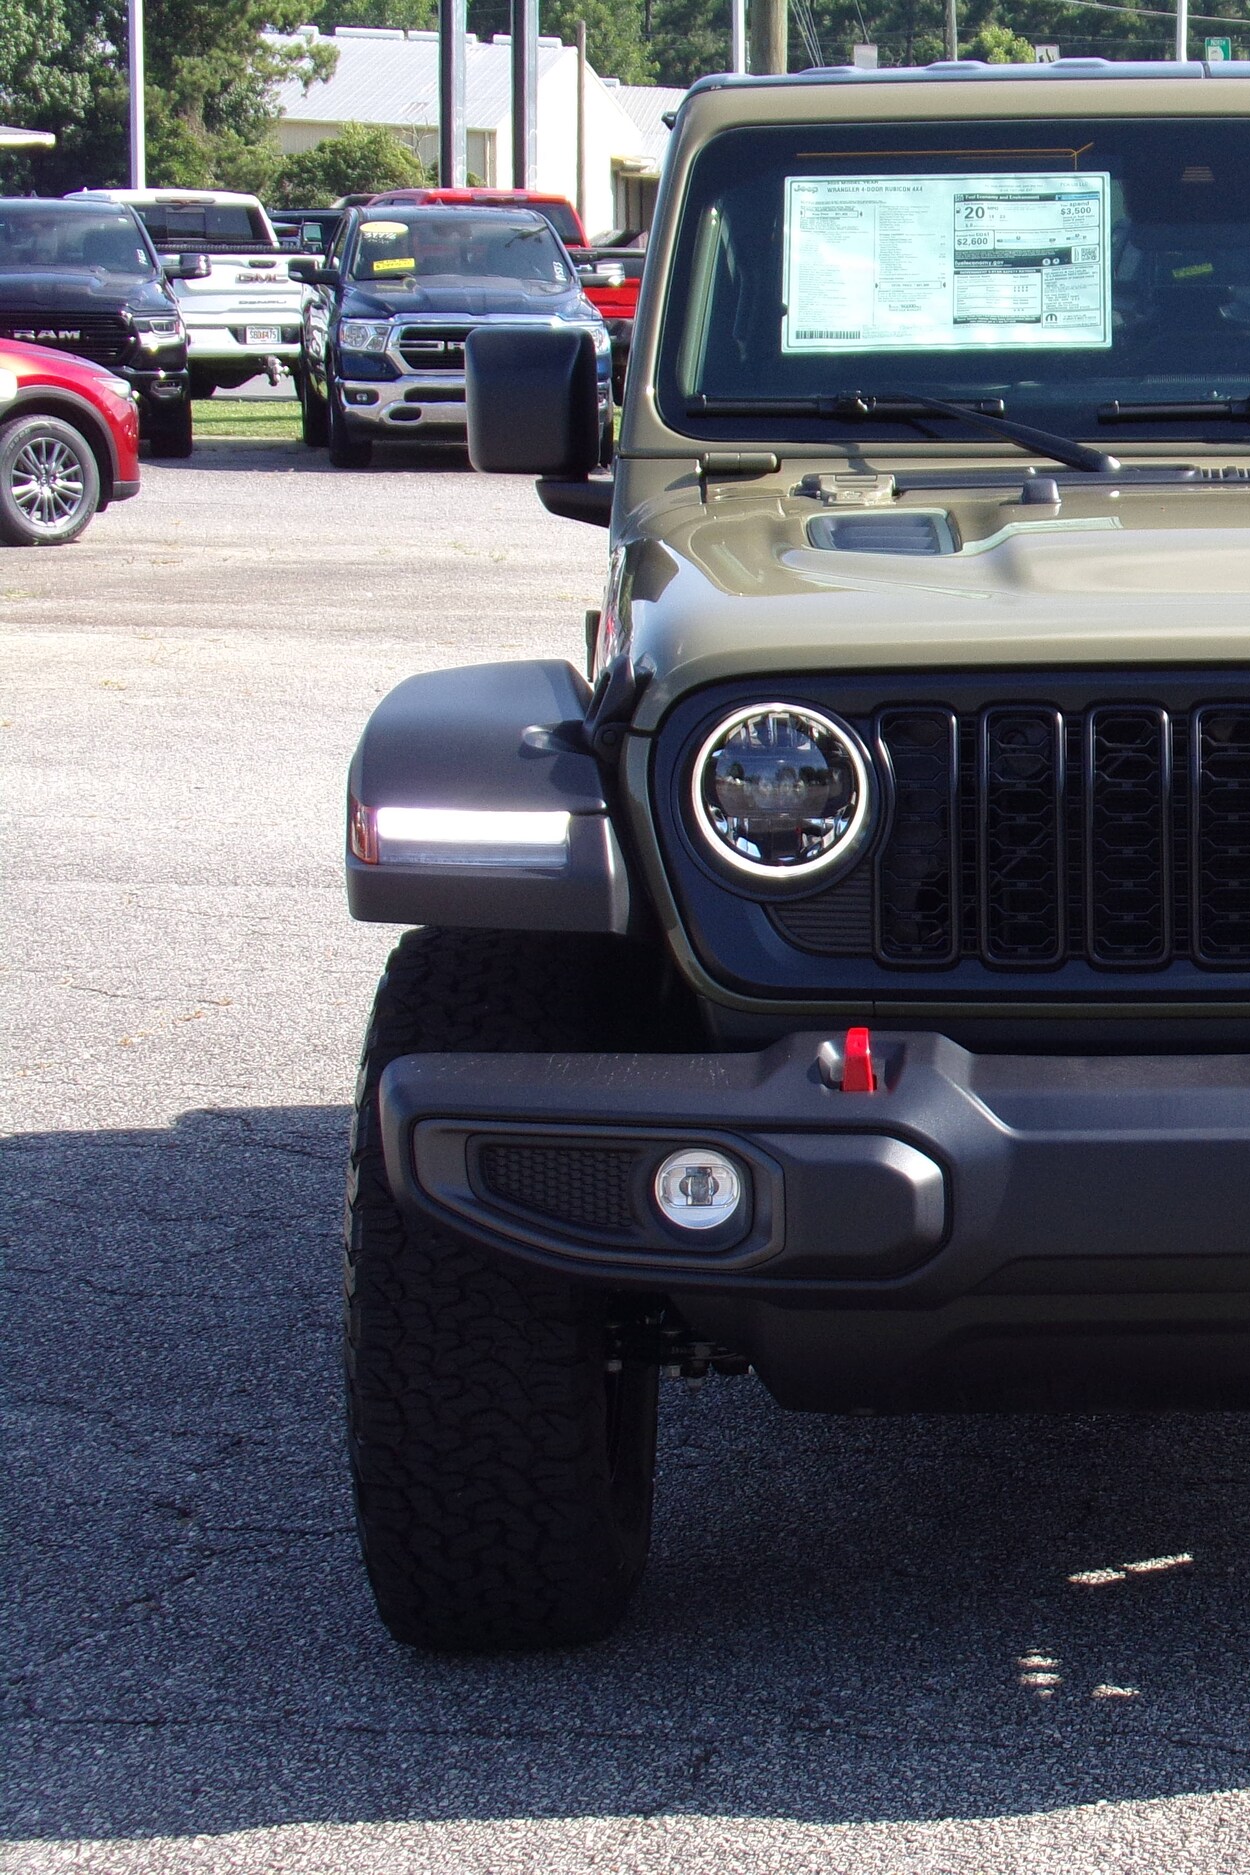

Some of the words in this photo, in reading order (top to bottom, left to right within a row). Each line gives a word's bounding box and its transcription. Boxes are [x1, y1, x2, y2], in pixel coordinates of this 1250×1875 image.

[964, 206, 986, 220] 20
[1060, 206, 1092, 216] $3,500
[957, 238, 988, 246] $2,600
[235, 272, 289, 284] GMC
[14, 329, 81, 340] RAM
